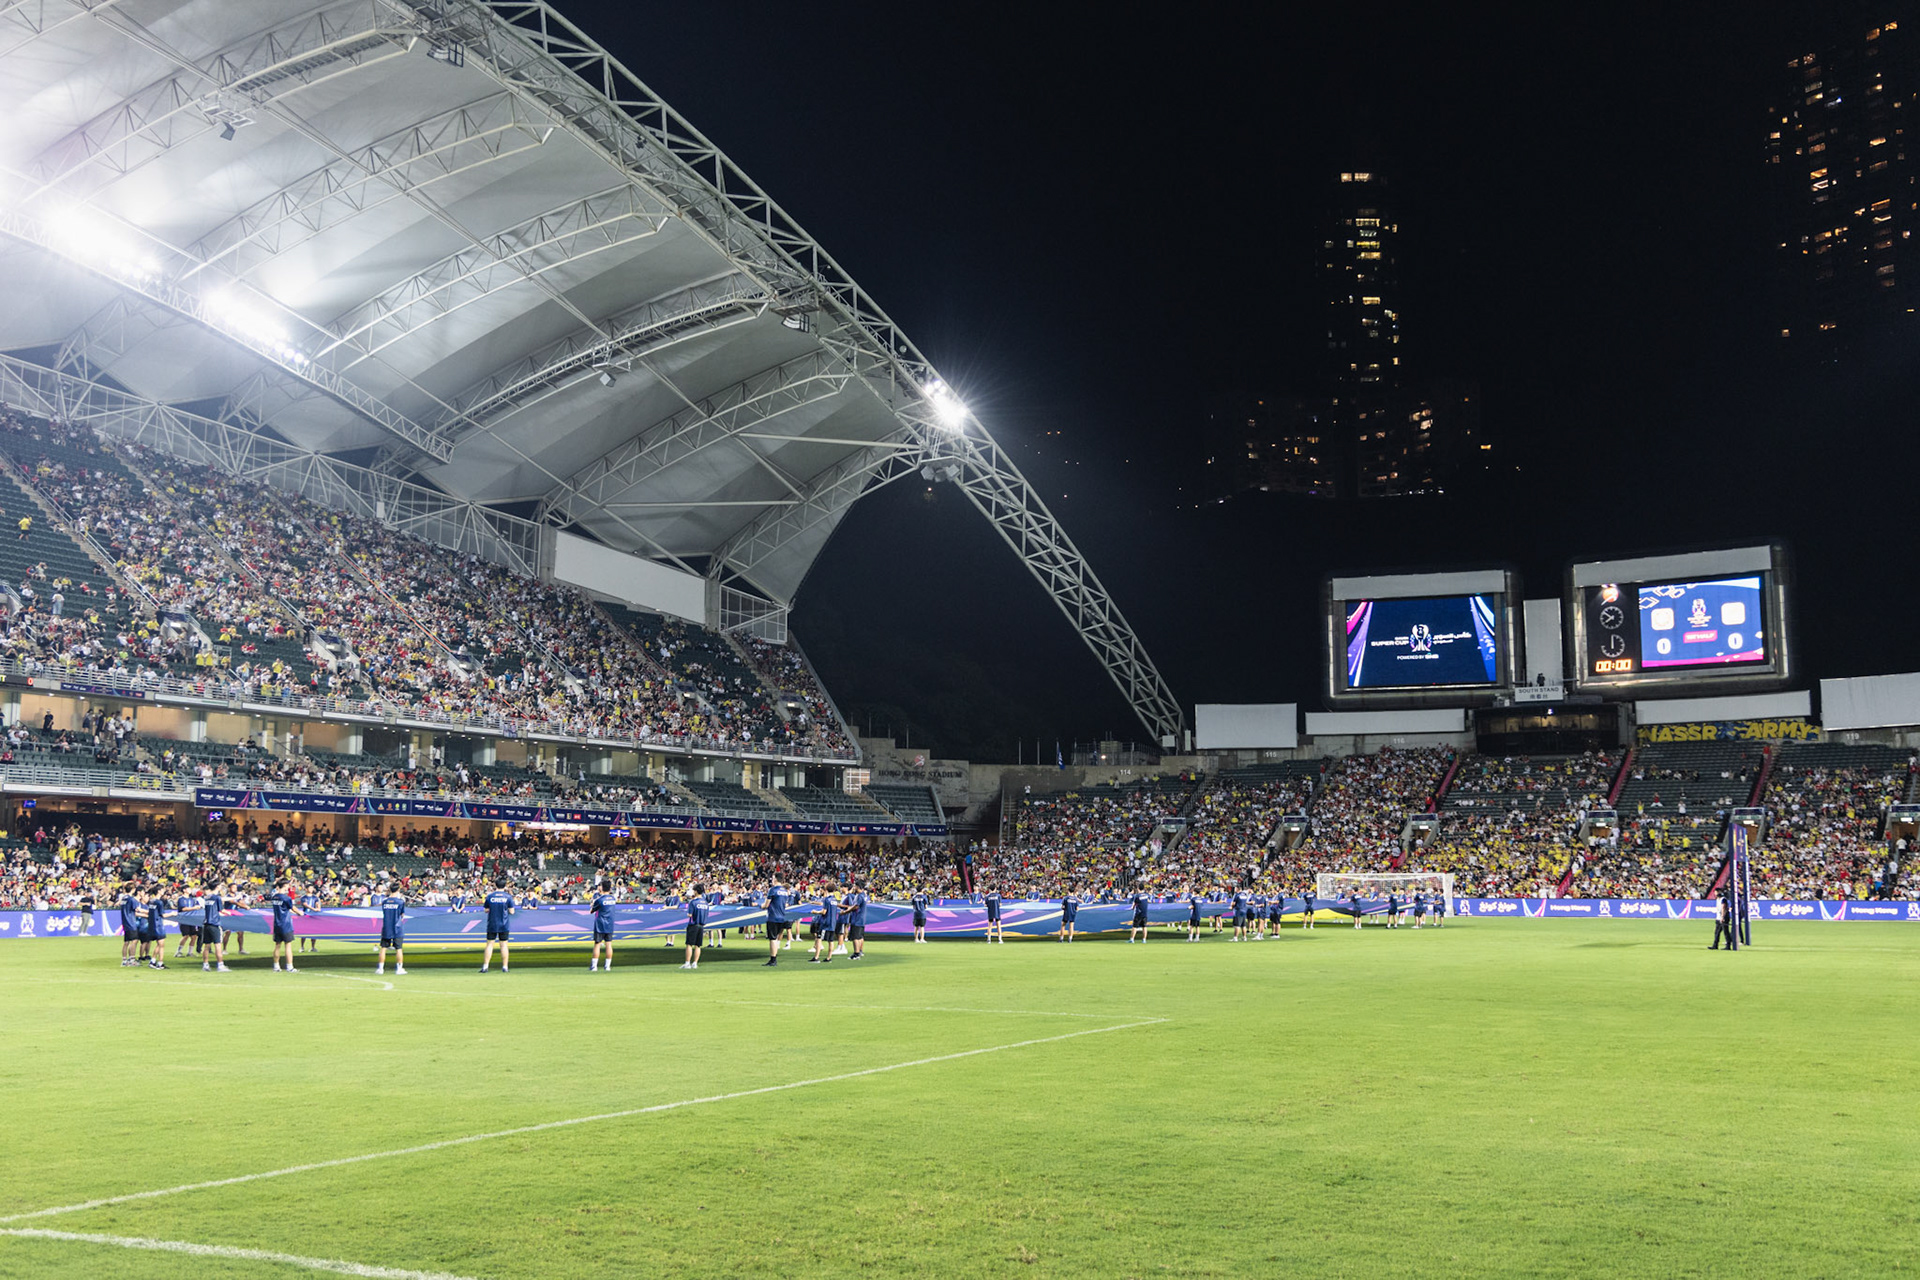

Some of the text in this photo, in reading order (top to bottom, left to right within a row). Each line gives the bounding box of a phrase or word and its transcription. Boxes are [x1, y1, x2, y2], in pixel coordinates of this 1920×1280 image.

[1656, 638, 1671, 654] 0
[1728, 632, 1743, 650] 0
[1595, 659, 1632, 672] 00:00
[1646, 722, 1812, 742] NASSR ARMY
